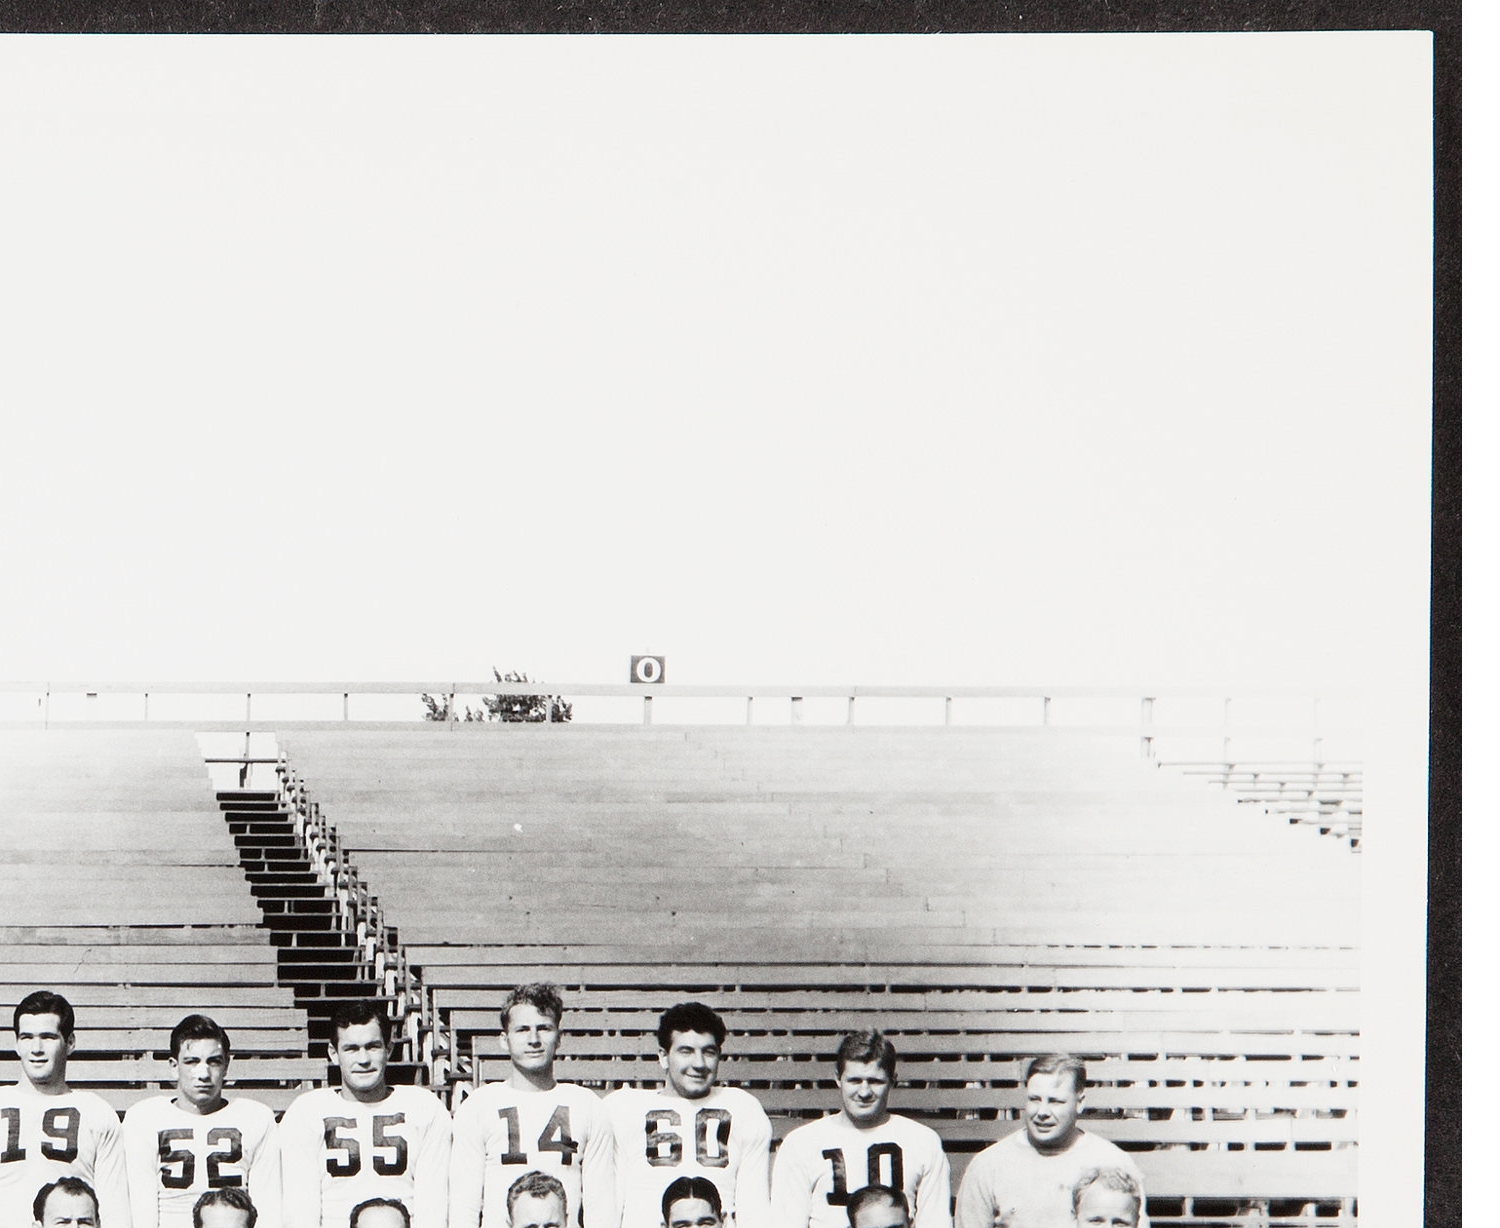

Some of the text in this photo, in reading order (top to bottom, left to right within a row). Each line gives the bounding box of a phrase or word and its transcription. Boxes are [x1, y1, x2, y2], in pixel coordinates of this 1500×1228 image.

[0, 1107, 80, 1163] 19
[157, 1128, 243, 1188] 52
[322, 1112, 408, 1176] 55
[499, 1105, 578, 1165] 14
[645, 1109, 732, 1168] 60
[822, 1142, 903, 1207] 10
